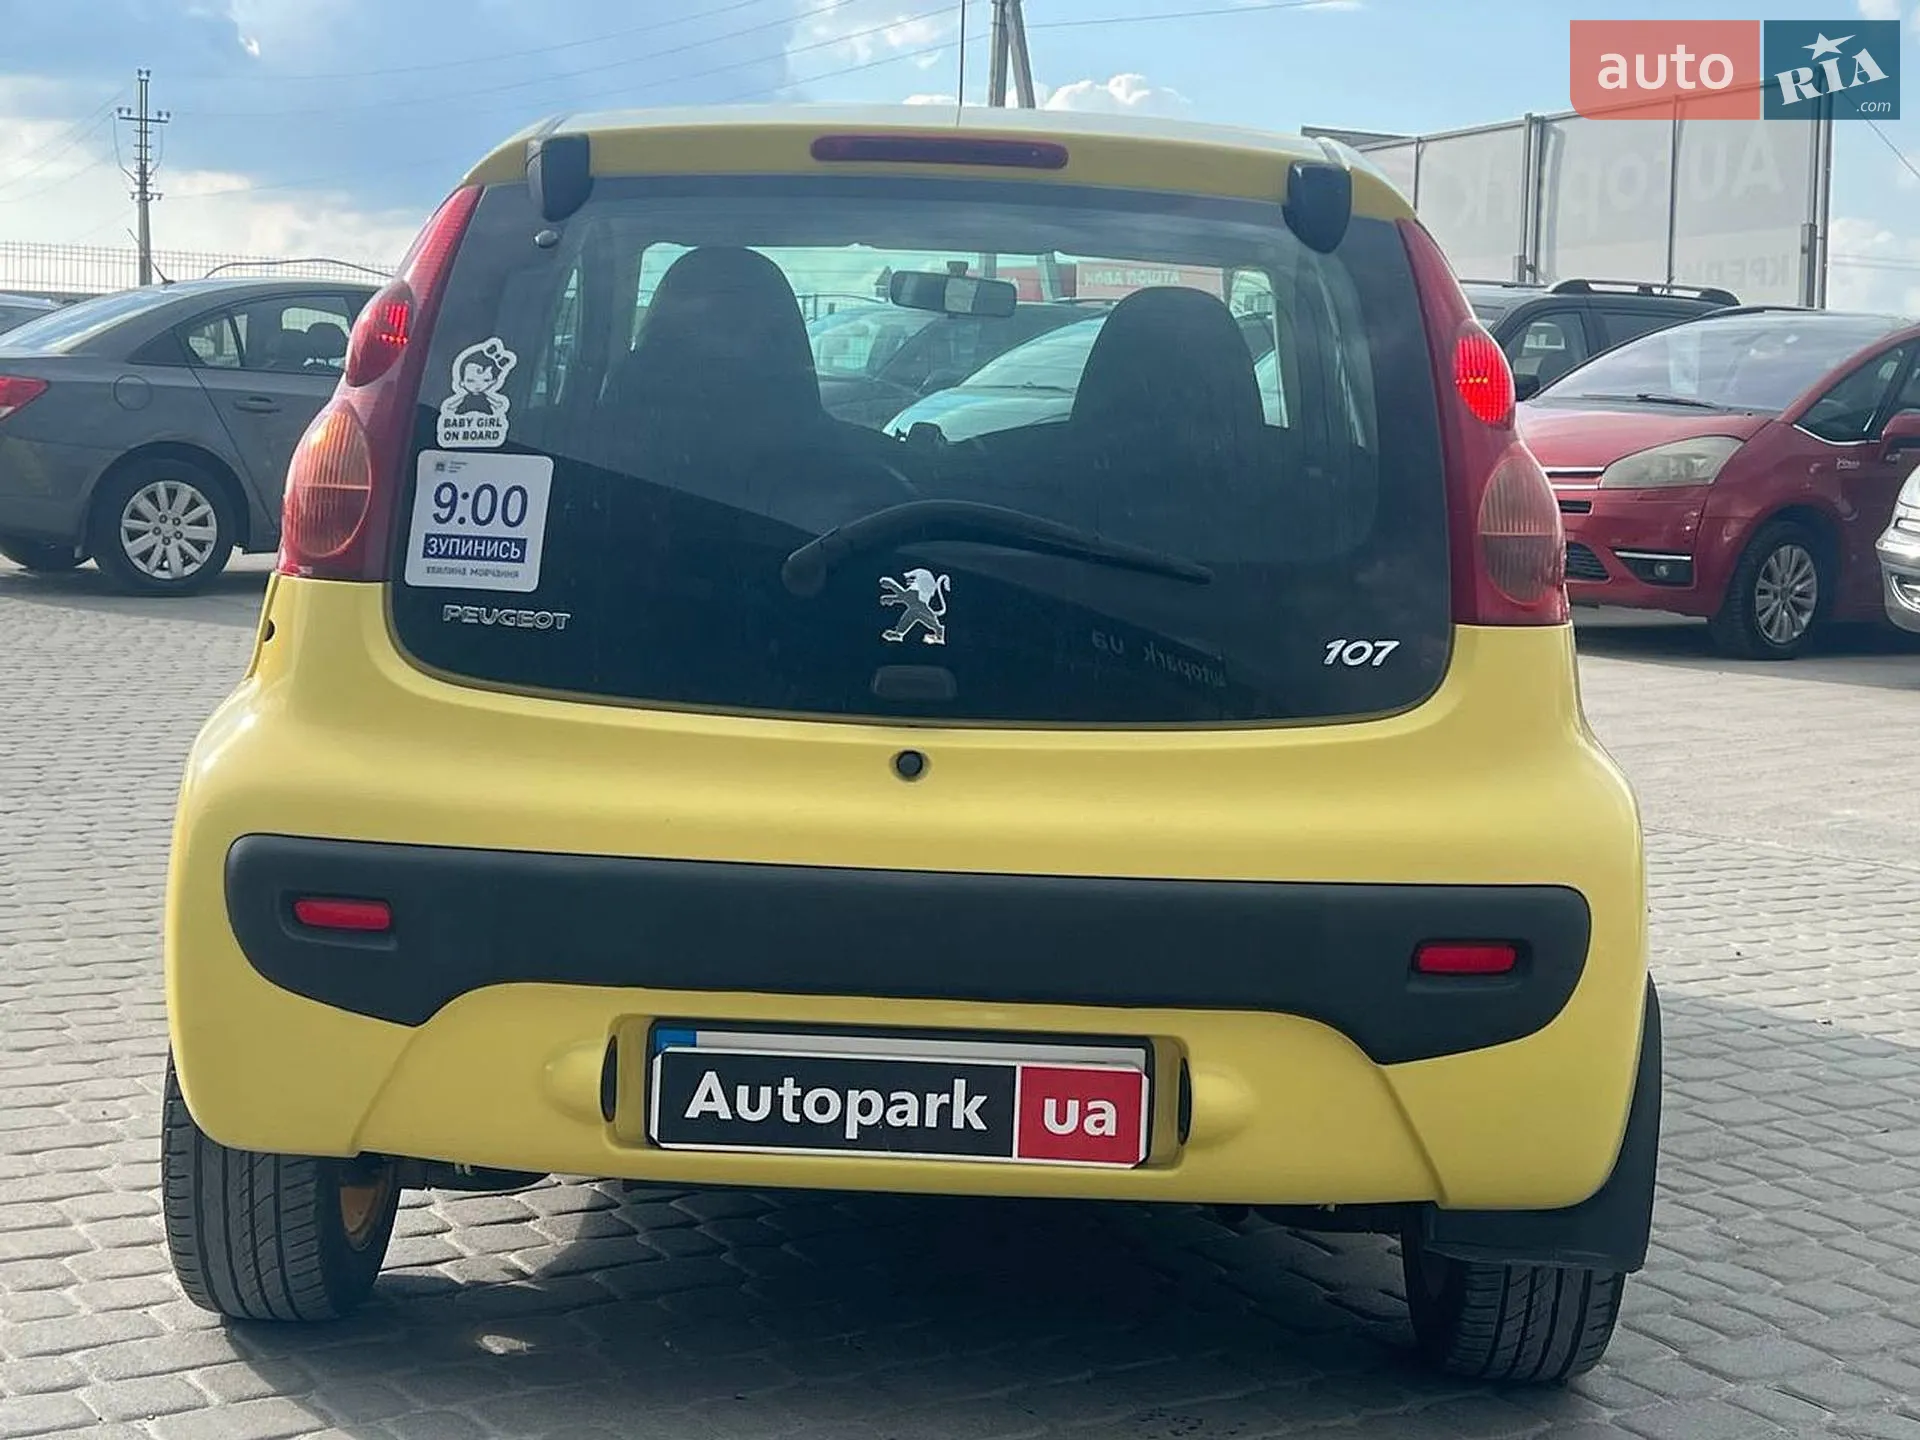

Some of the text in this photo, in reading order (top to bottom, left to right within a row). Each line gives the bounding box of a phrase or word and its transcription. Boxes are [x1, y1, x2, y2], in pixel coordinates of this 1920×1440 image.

[443, 430, 500, 441] ON BOARD
[444, 417, 503, 428] BABY GIRL
[432, 481, 529, 528] 9:00
[427, 536, 521, 560] ЗУПИНИСЬ
[443, 604, 571, 630] PEUGEOT
[1323, 639, 1400, 666] 107
[684, 1070, 1117, 1139] Autopark ua
